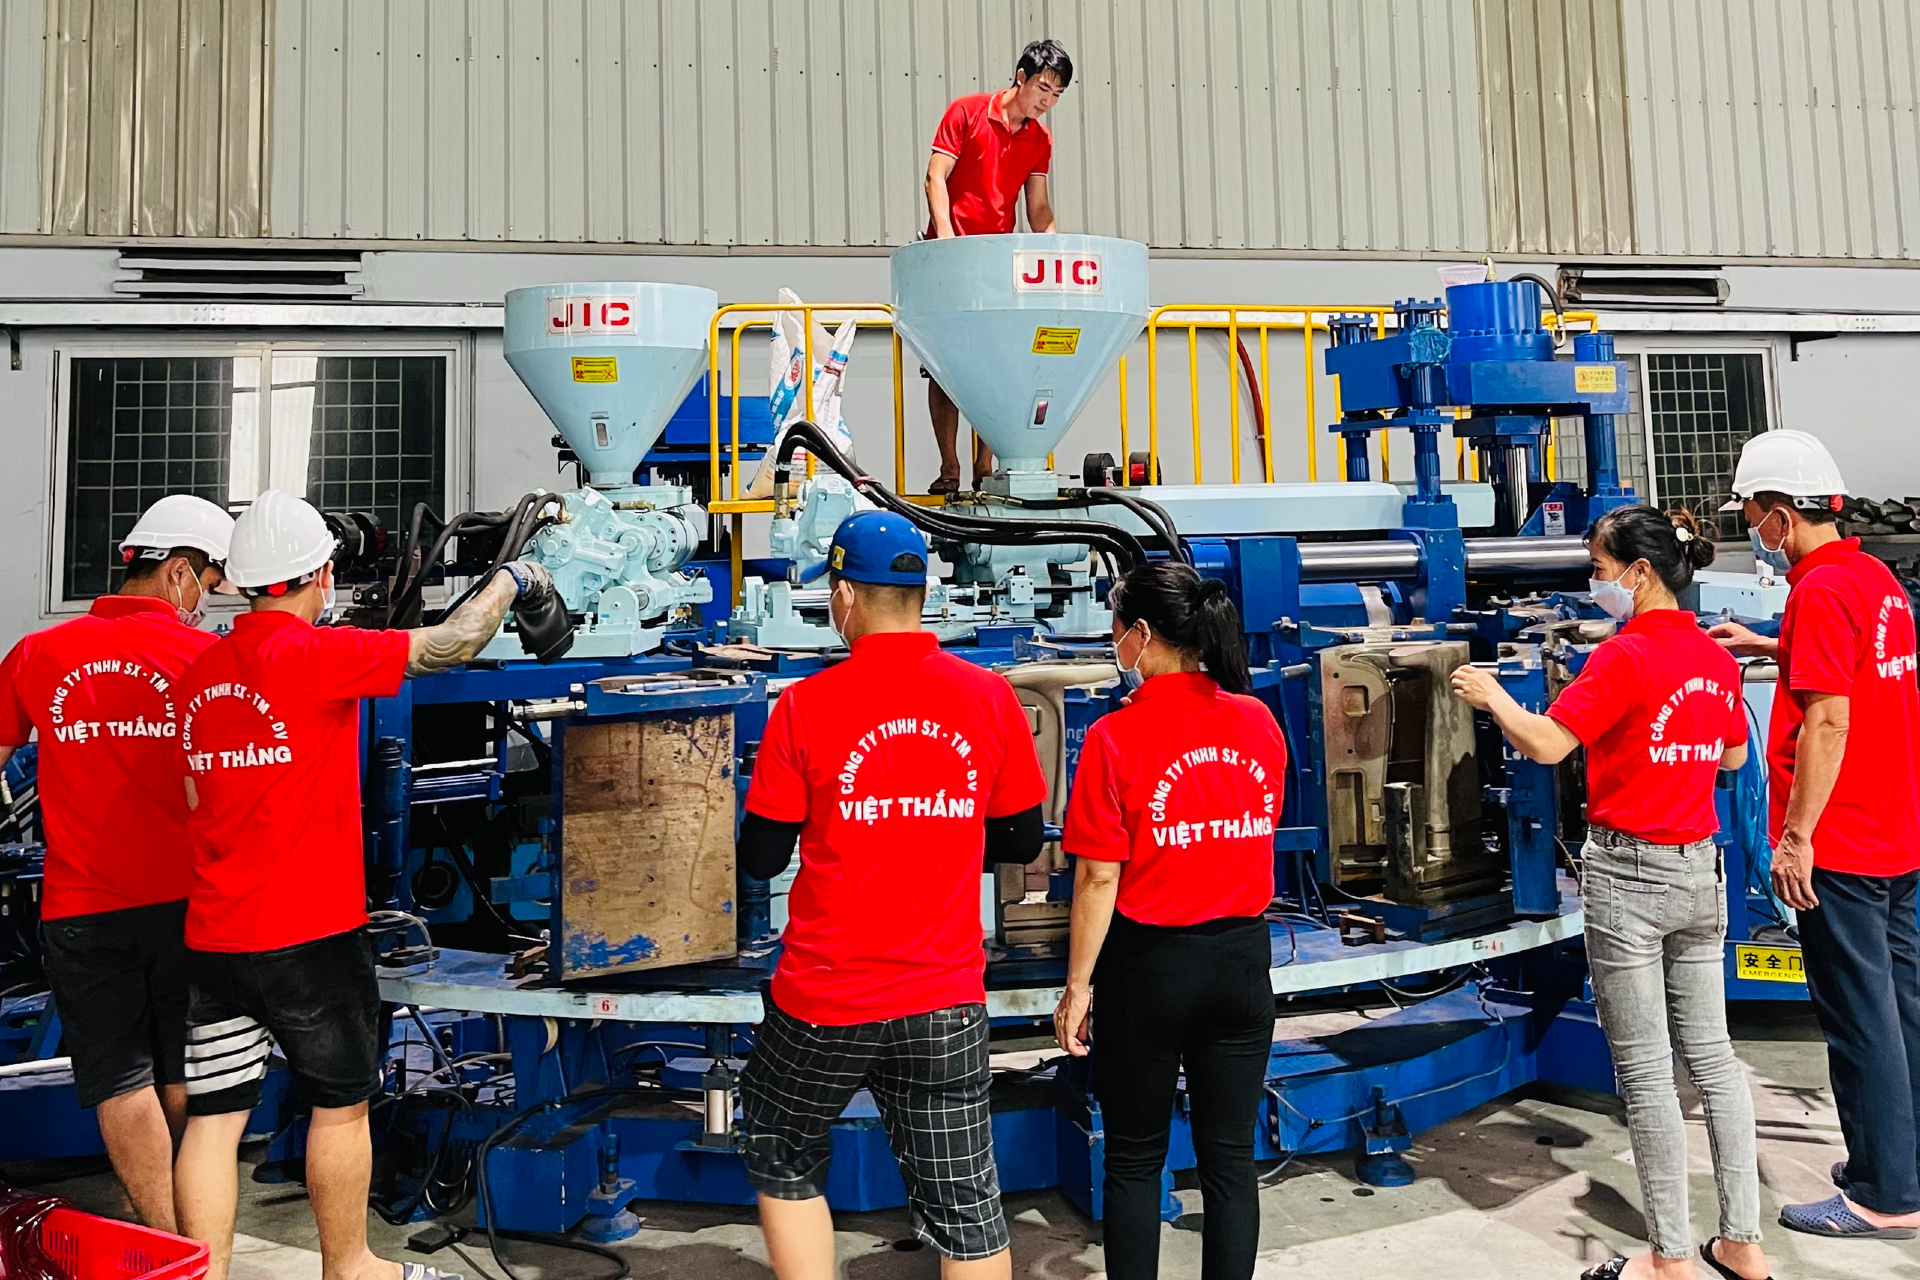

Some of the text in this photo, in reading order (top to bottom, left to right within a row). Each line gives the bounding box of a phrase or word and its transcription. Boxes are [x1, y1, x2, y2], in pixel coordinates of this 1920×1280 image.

[1022, 259, 1098, 285] JIC
[552, 302, 630, 328] JIC
[49, 686, 69, 724] CÔNG
[63, 668, 81, 687] TY
[83, 660, 121, 676] TNHH
[124, 662, 142, 677] SX
[149, 672, 170, 693] TM
[189, 694, 202, 713] TY
[204, 682, 232, 702] TNHH
[233, 683, 248, 700] SX
[252, 692, 271, 715] TM
[271, 721, 289, 740] DV
[1650, 704, 1674, 742] CÔNG
[1669, 687, 1684, 707] TY
[1706, 679, 1719, 696] SX
[54, 715, 177, 744] VIỆT THẮNG
[219, 742, 293, 768] THẮNG
[838, 717, 978, 795] CÔNG TY TNHH SX TM DV
[1648, 741, 1692, 766] VIỆT
[1148, 746, 1274, 822] CÔNG TY TNHH SX TM DV
[838, 789, 975, 826] VIỆT THẮNG
[1152, 810, 1273, 849] VIỆT THẮNG
[1744, 952, 1803, 972] 安全门
[602, 1000, 610, 1011] 6
